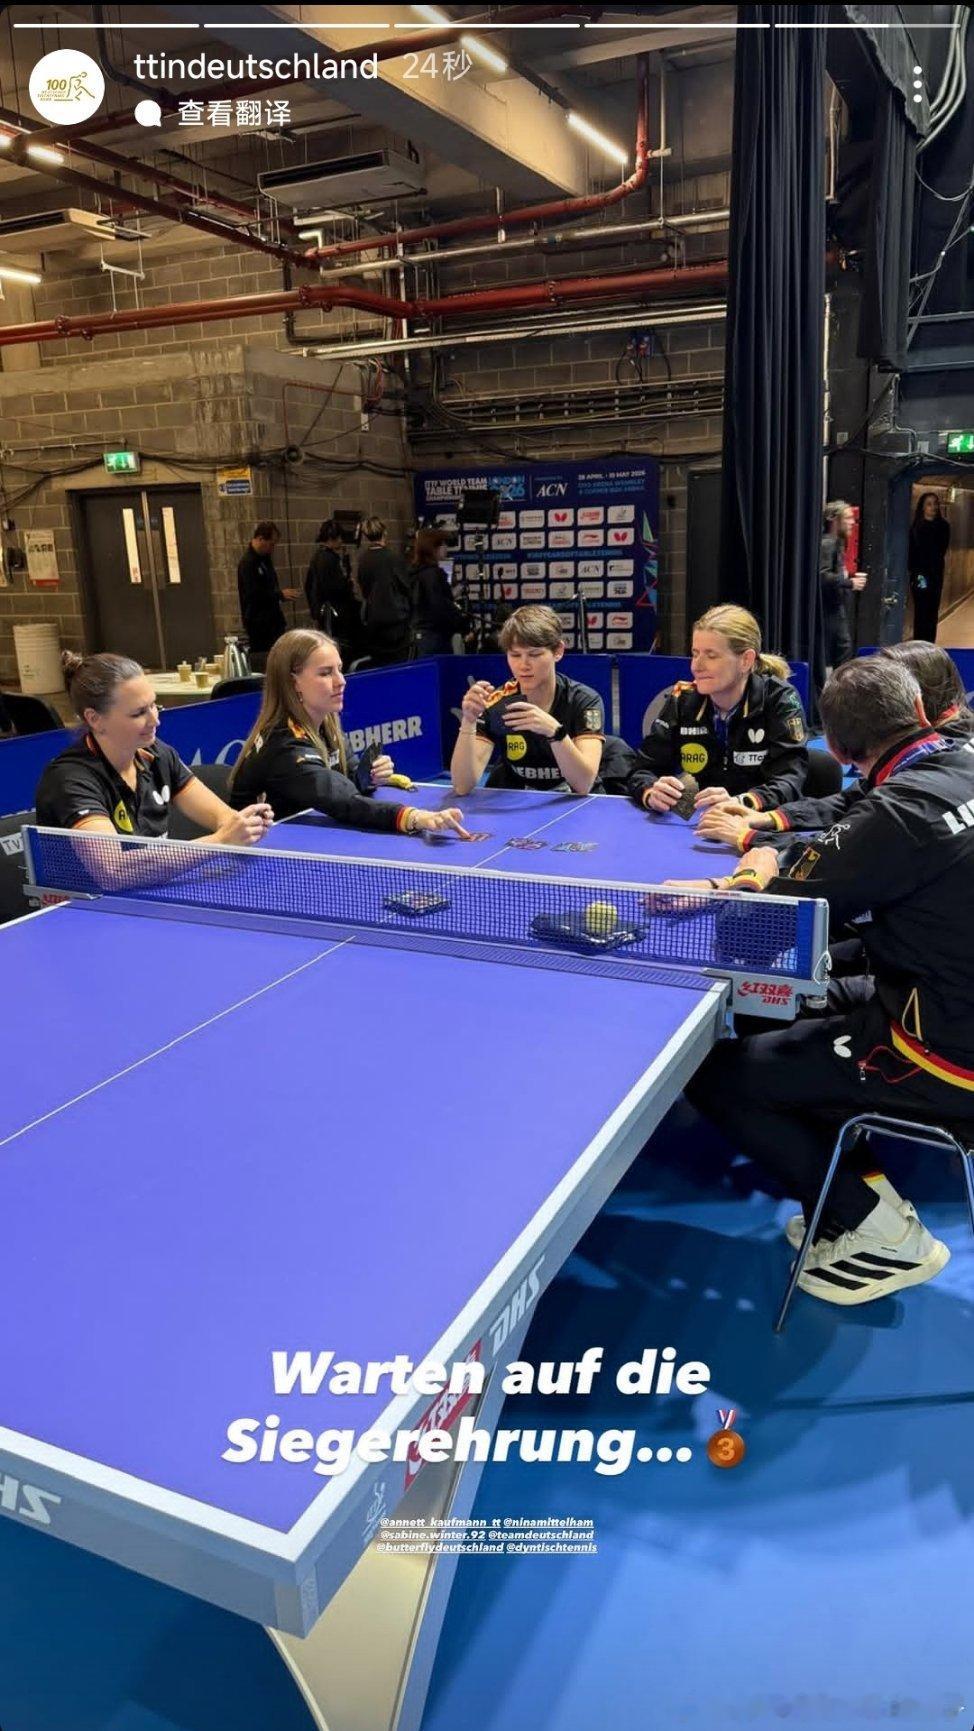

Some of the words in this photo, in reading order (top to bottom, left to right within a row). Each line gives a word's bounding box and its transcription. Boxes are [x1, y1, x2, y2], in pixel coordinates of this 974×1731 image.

[440, 478, 466, 486] WORLD
[467, 477, 488, 485] TEAM
[426, 486, 453, 495] TABLE
[536, 483, 568, 498] ACN
[344, 716, 423, 752] BHERR
[508, 742, 525, 752] RAG
[681, 752, 706, 763] ARAG
[489, 1254, 546, 1358] DHS
